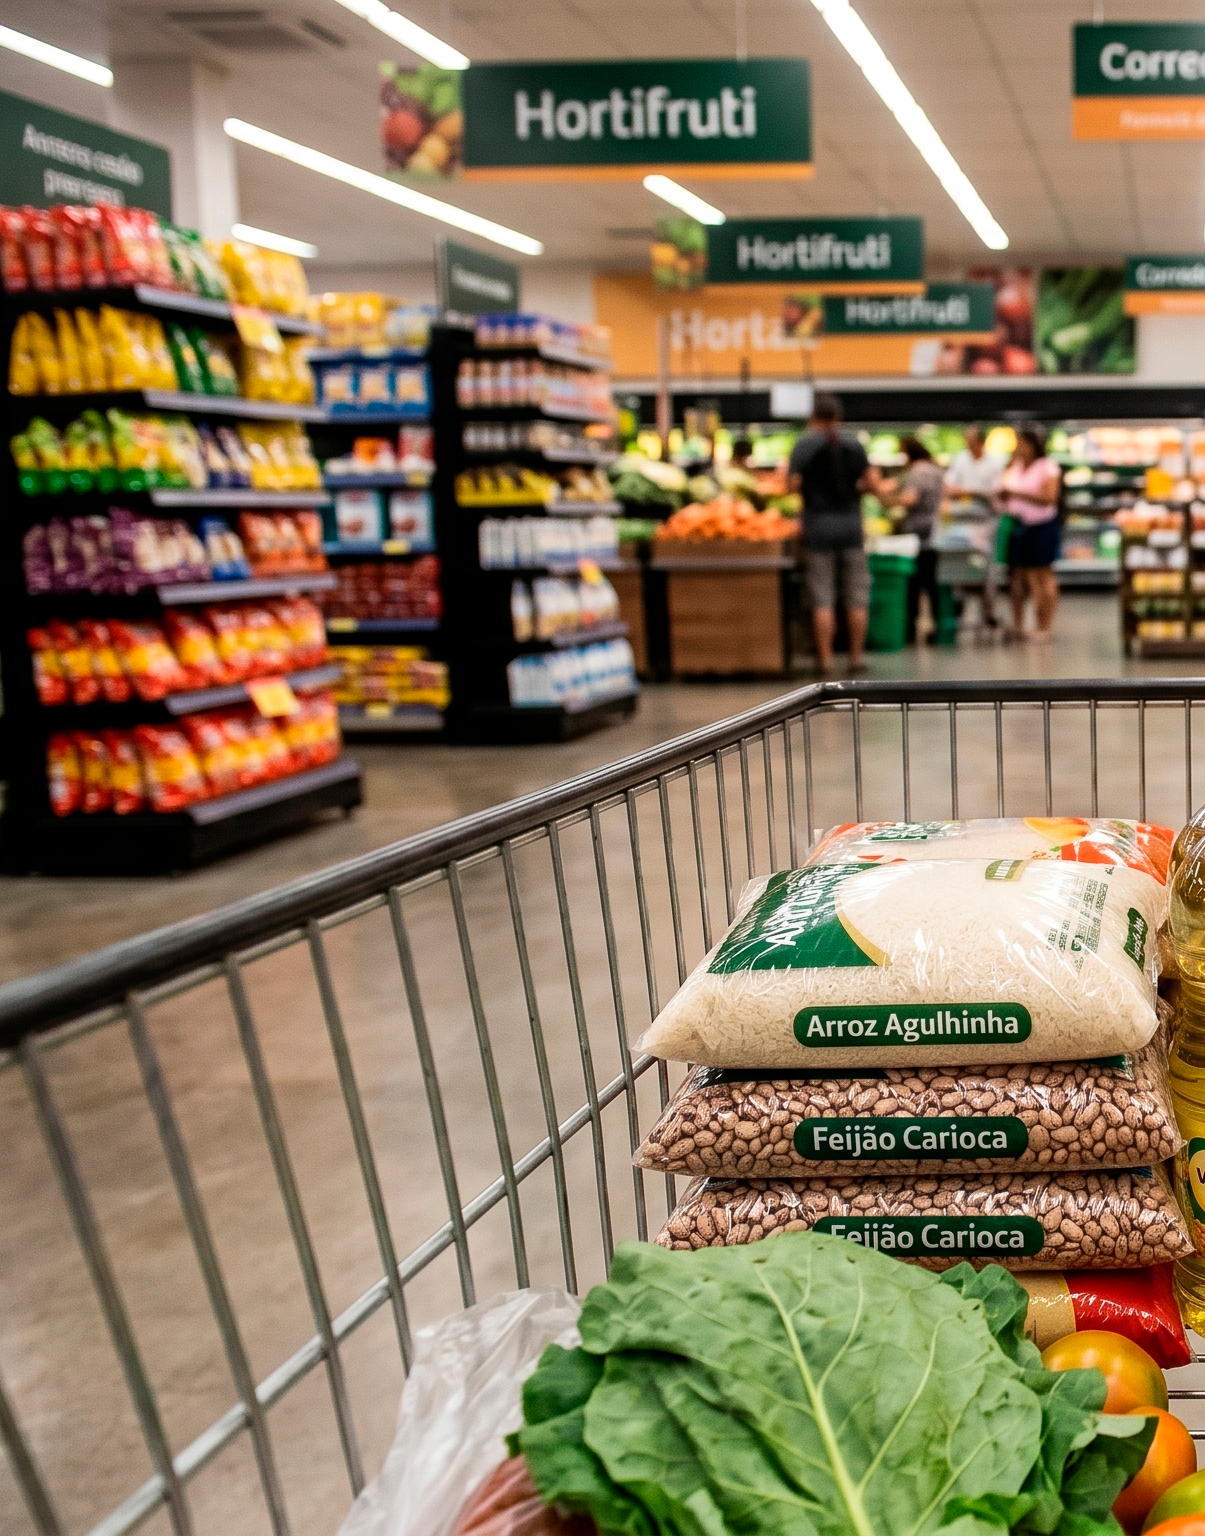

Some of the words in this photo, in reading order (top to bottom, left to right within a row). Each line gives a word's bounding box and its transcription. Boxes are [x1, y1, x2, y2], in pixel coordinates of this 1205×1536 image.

[515, 84, 757, 139] Hortifruti
[736, 233, 892, 270] Hortifruti
[806, 1015, 878, 1038] Arroz
[884, 1010, 1019, 1042] Agulhinha
[813, 1124, 896, 1157] Feijão
[903, 1124, 1008, 1149] Carioca
[921, 1223, 1025, 1248] Carioca
